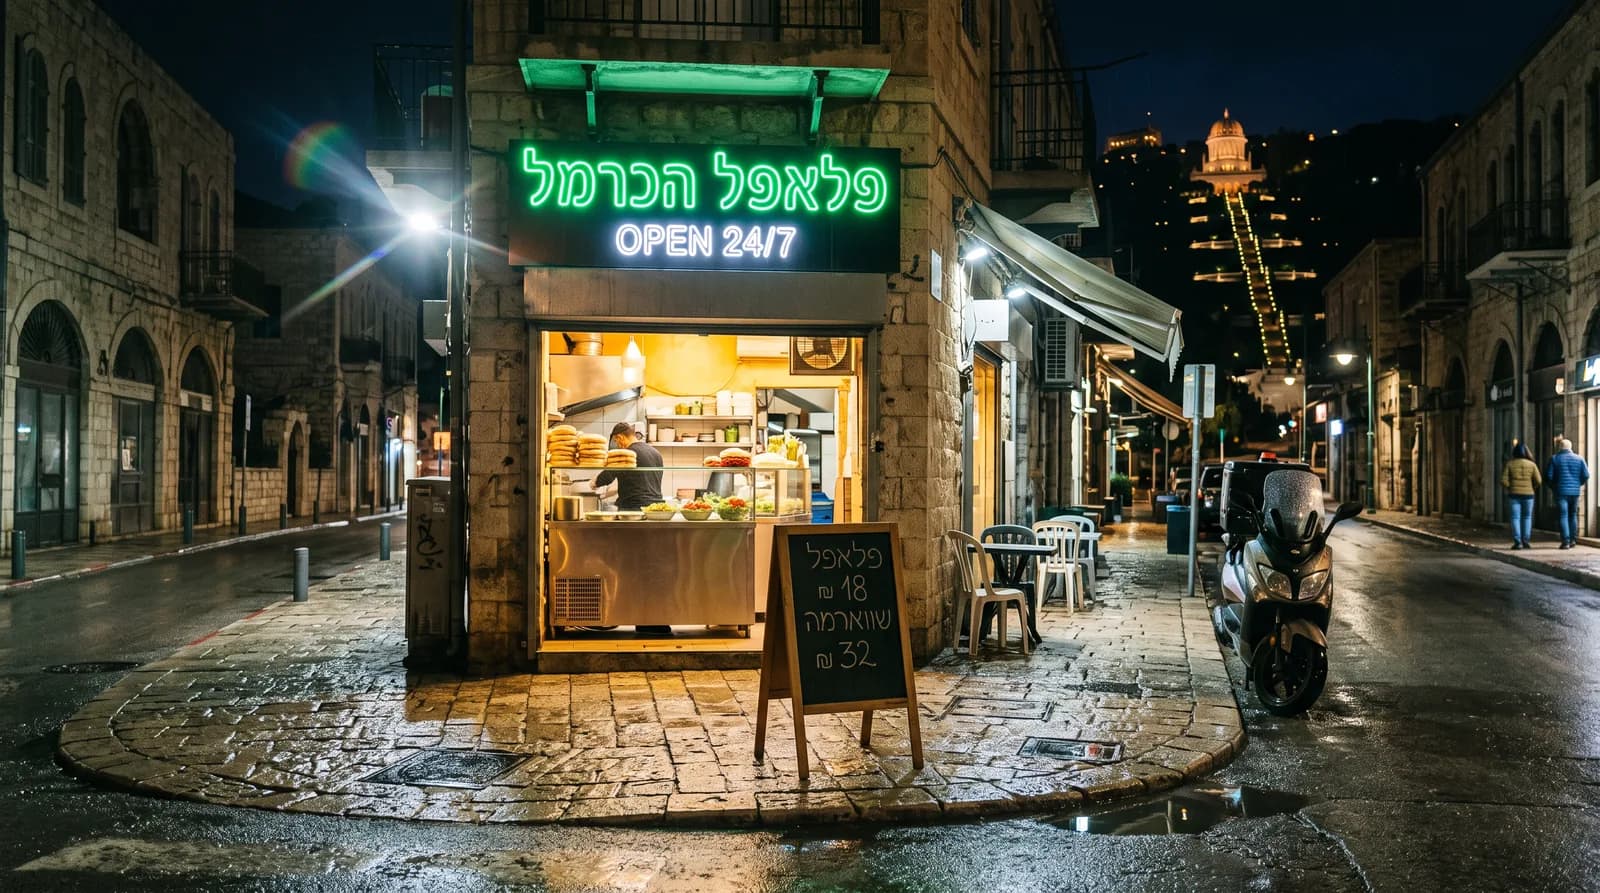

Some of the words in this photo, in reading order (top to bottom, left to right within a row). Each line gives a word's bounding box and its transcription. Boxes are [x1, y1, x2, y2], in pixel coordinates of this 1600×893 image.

[521, 145, 697, 210] הכרמל
[713, 150, 889, 215] פלאפל
[614, 223, 714, 258] OPEN
[721, 225, 798, 260] 24/7
[805, 540, 882, 569] פלאפל
[818, 586, 833, 599] ₪
[841, 574, 867, 601] 18
[804, 609, 891, 632] שווארמה
[816, 652, 833, 669] ₪
[839, 640, 877, 669] 32
